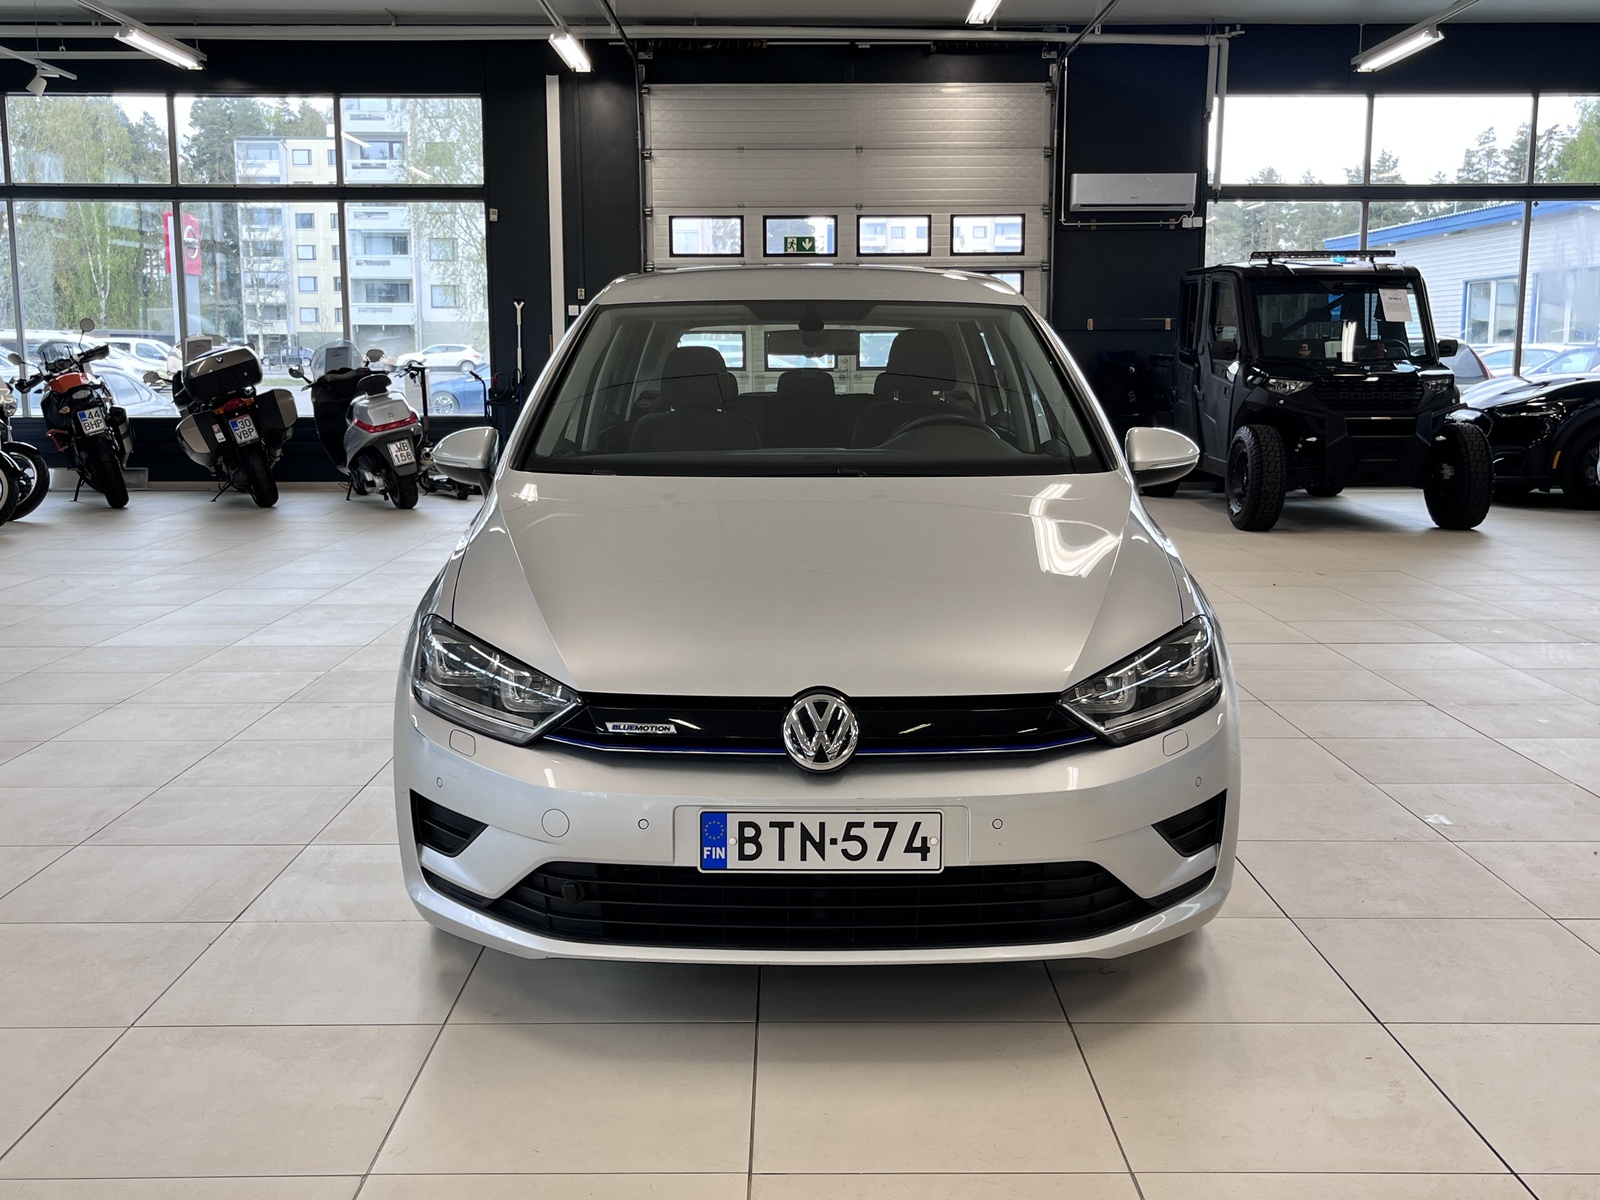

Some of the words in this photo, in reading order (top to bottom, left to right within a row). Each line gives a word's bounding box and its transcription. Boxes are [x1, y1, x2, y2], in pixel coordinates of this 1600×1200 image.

[1338, 391, 1406, 401] POLARIS
[87, 410, 100, 420] 44
[83, 418, 103, 431] BHP
[237, 418, 252, 429] 30
[235, 427, 255, 440] VBP
[394, 451, 413, 463] 158
[611, 724, 671, 732] BLUEMOTION
[703, 847, 725, 859] FIN
[737, 820, 931, 862] BTN-574
